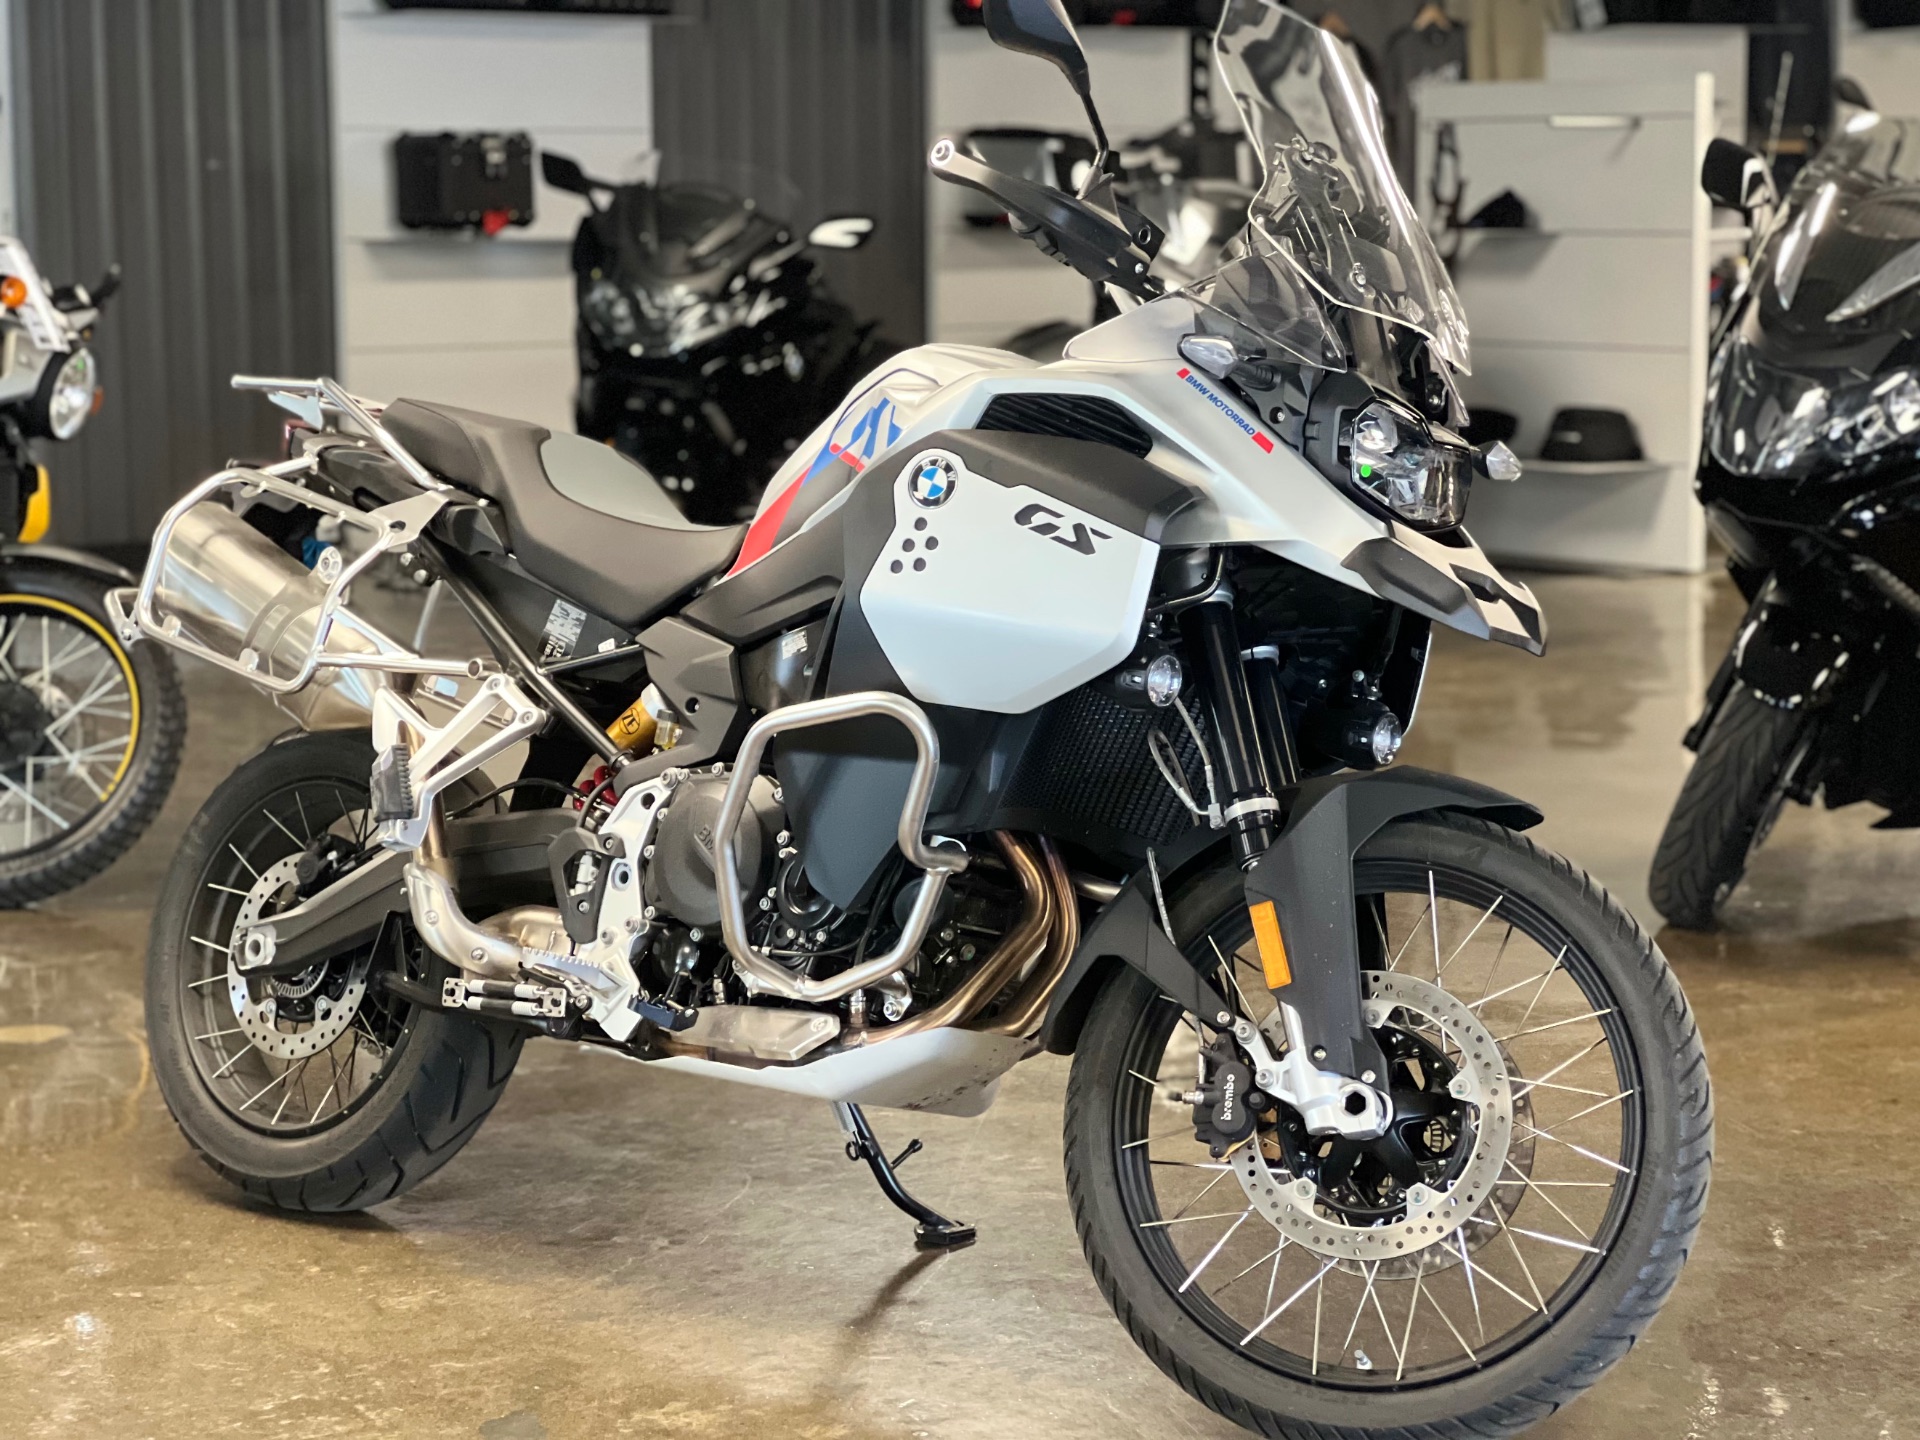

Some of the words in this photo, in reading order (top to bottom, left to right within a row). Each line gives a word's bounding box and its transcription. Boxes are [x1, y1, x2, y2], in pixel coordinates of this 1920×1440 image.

[1185, 375, 1210, 395] BMW
[1207, 393, 1255, 435] MOTORRAD
[1014, 503, 1113, 555] GS
[1220, 1073, 1236, 1121] brembo
